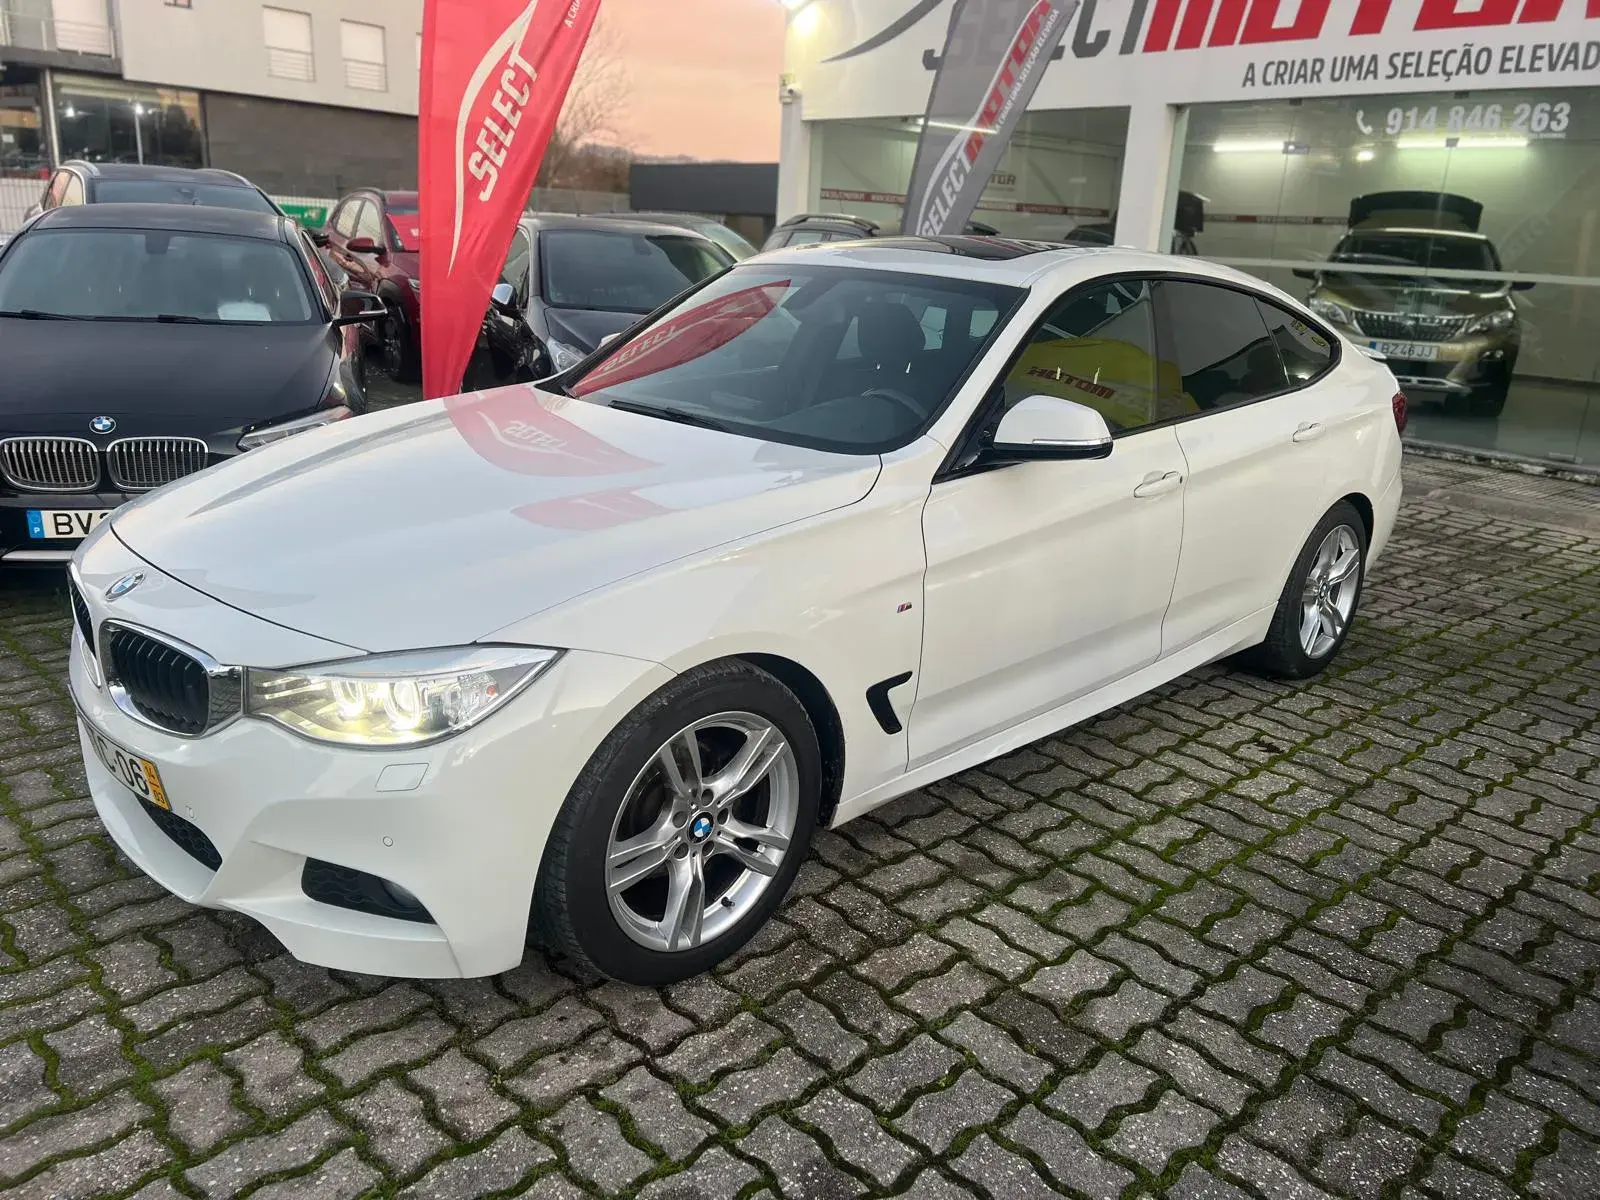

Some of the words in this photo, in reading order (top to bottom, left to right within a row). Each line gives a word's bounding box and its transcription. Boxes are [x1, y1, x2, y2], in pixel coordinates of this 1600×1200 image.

[1242, 62, 1256, 87] A
[1262, 57, 1326, 86] CRIAR
[1330, 54, 1378, 83] UMA
[1385, 43, 1493, 82] SELEÇÃO
[468, 44, 537, 202] SELECT
[1386, 106, 1437, 134] 914
[1448, 104, 1503, 132] 846
[1512, 102, 1571, 132] 263
